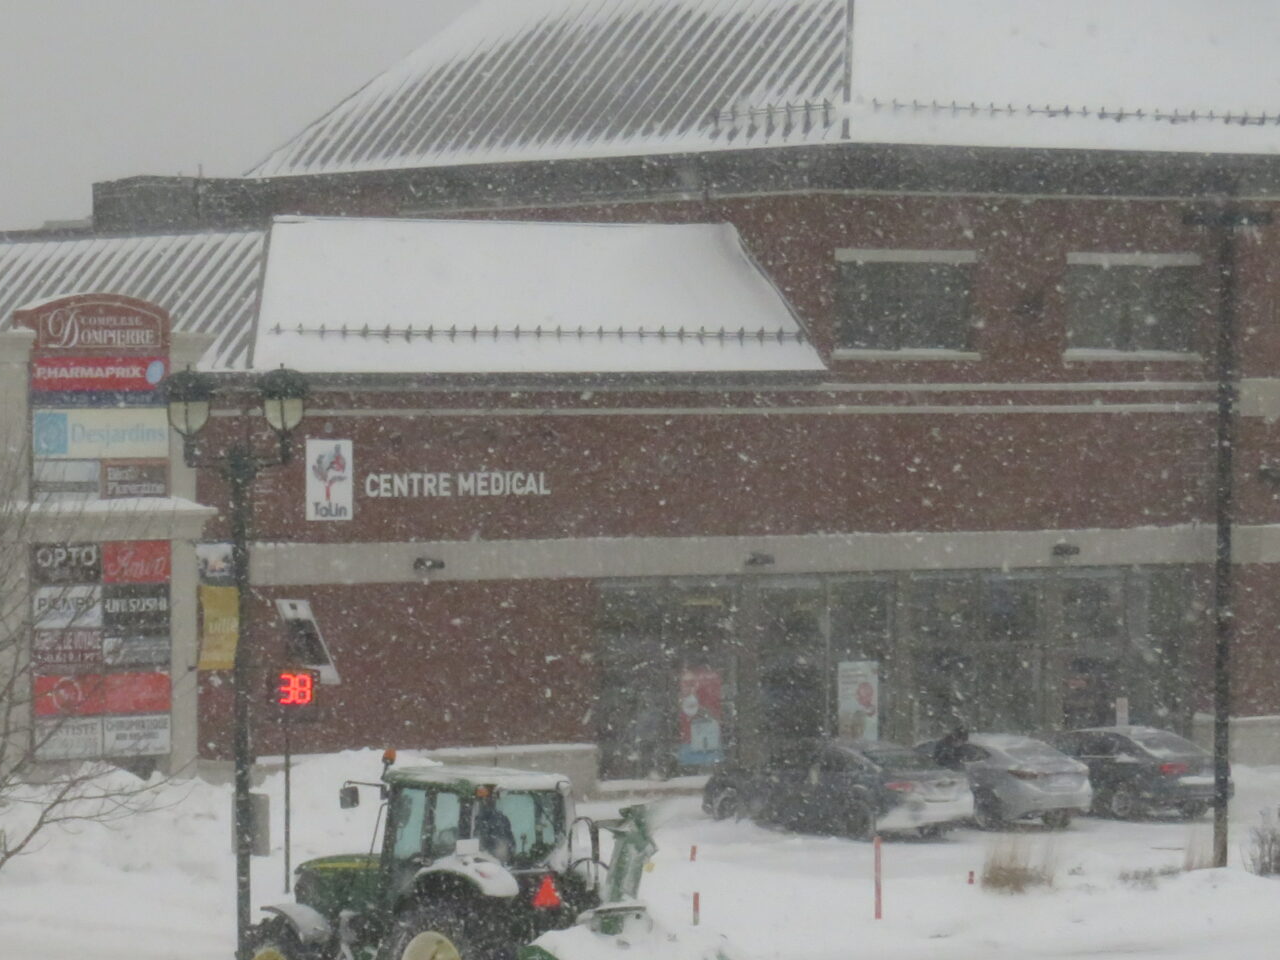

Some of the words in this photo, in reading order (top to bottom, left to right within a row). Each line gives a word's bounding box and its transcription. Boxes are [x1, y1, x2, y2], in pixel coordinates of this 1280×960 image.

[36, 366, 142, 378] PHARMAPRIX
[72, 424, 166, 446] Desjardins
[365, 473, 451, 497] CENTRE
[458, 465, 551, 496] MÉDICAL
[37, 547, 96, 568] OPTO
[280, 673, 313, 704] 38
